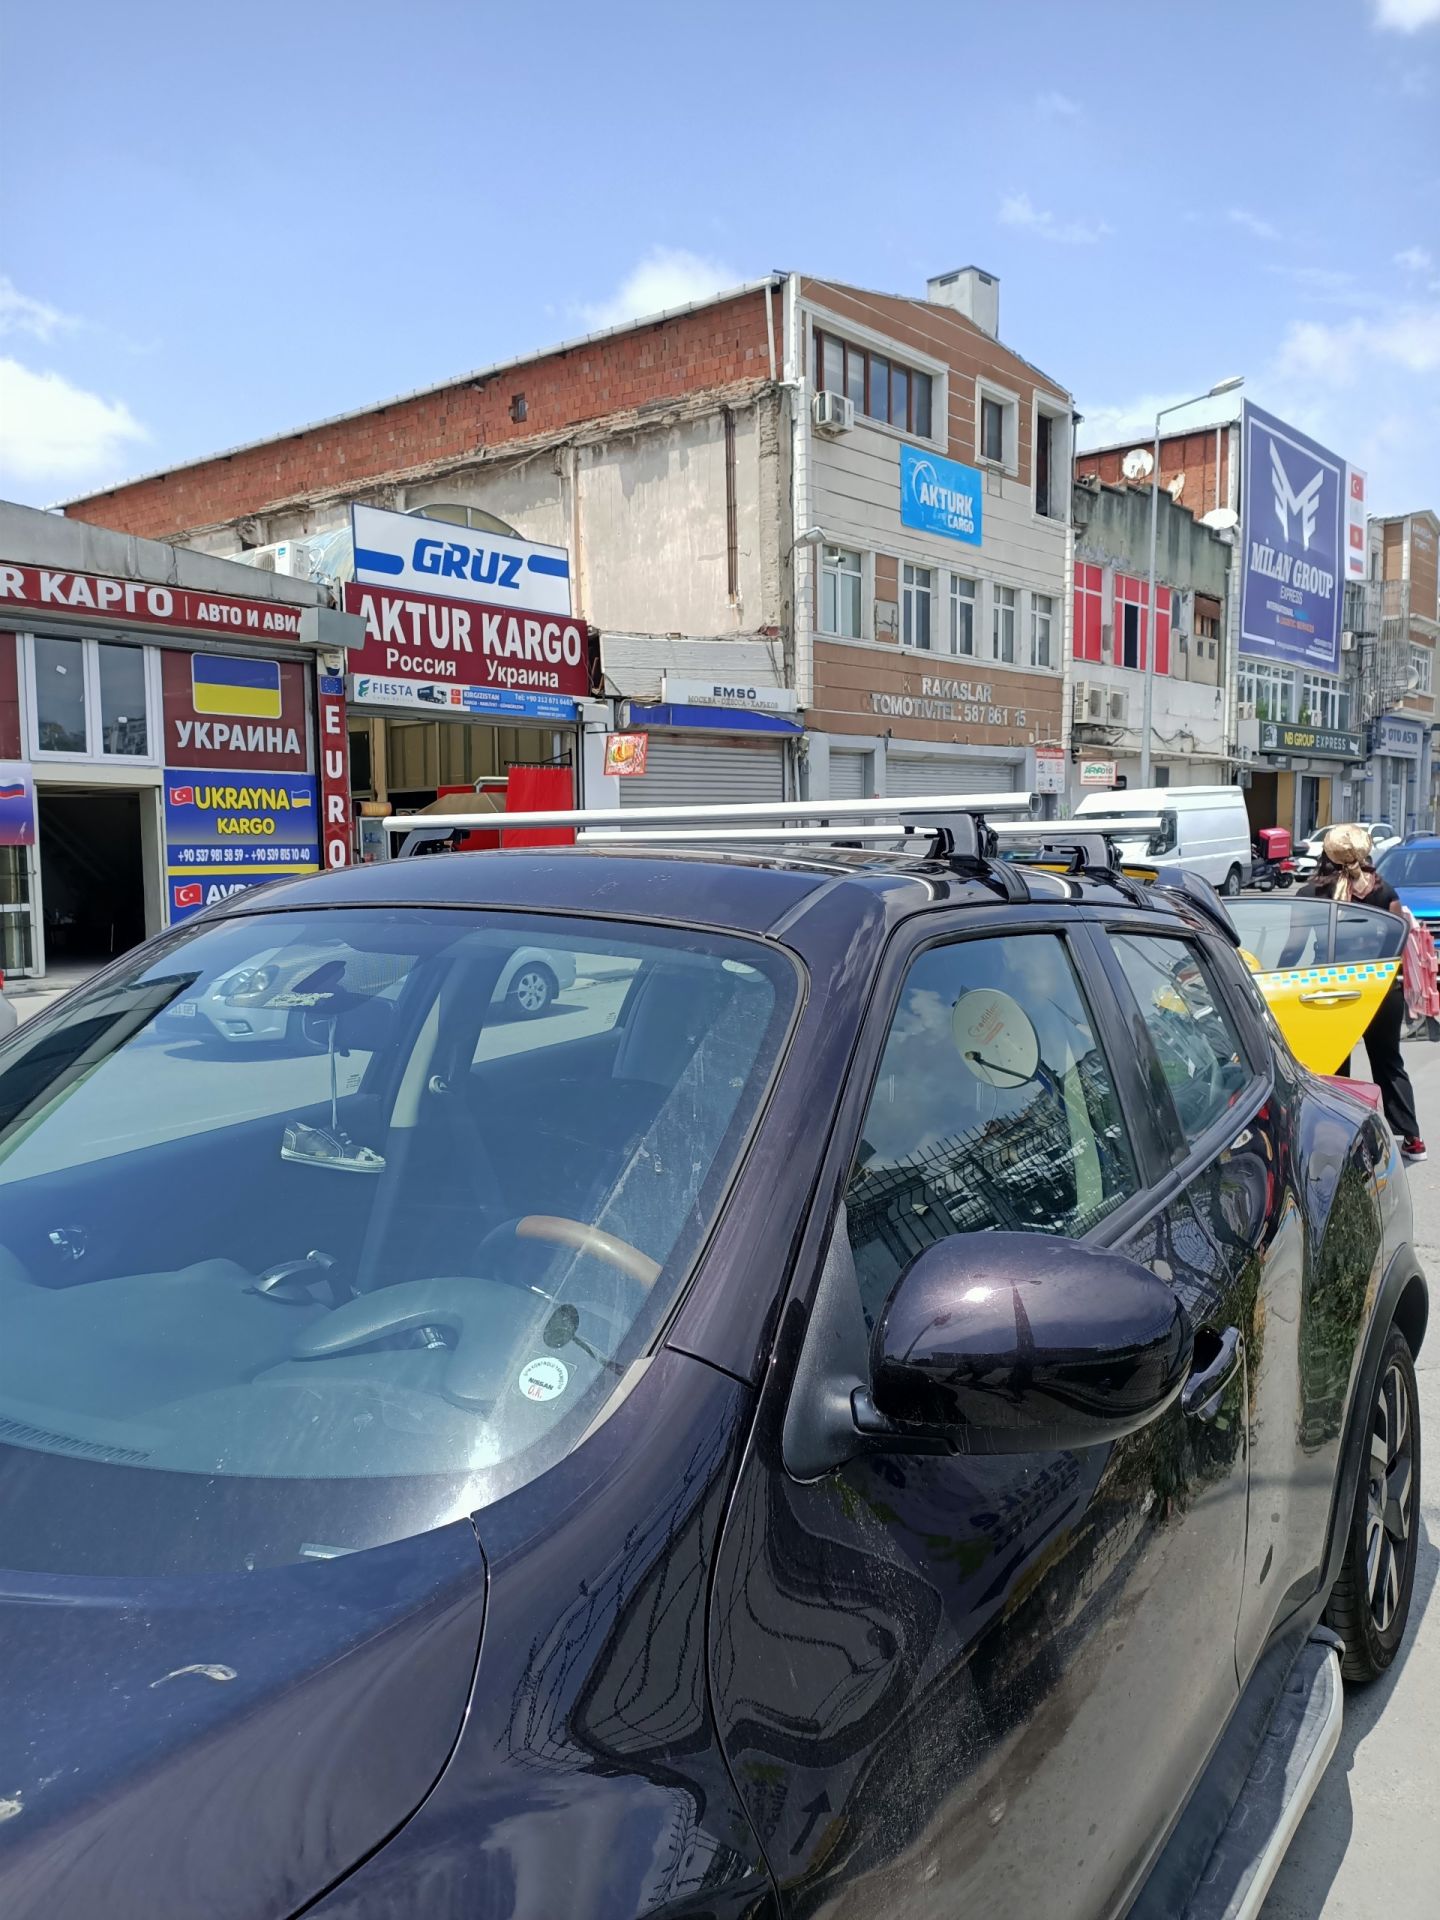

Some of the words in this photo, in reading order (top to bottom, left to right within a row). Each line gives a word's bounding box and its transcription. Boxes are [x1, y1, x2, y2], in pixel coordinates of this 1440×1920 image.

[946, 514, 975, 534] CARGO
[412, 538, 523, 589] GRUZ
[1293, 560, 1334, 599] GROUP
[40, 571, 174, 617] КАРГО
[197, 602, 242, 625] АВТО
[247, 609, 259, 628] И
[359, 594, 473, 652] AKTUR
[481, 612, 582, 665] KARGO
[386, 648, 457, 677] Россия
[486, 659, 559, 688] Украина
[372, 682, 413, 697] FIESTA
[713, 686, 757, 699] EMSÖ
[963, 704, 985, 723] 587
[175, 720, 301, 755] УКРАИНА
[1294, 733, 1315, 747] GROUP
[1316, 735, 1347, 751] EXPRESS
[194, 786, 290, 811] UKRAYNA
[217, 817, 275, 835] KARGO
[178, 849, 194, 862] +90
[251, 849, 266, 861] +90
[300, 848, 310, 860] 40
[528, 1376, 554, 1391] NISSAN
